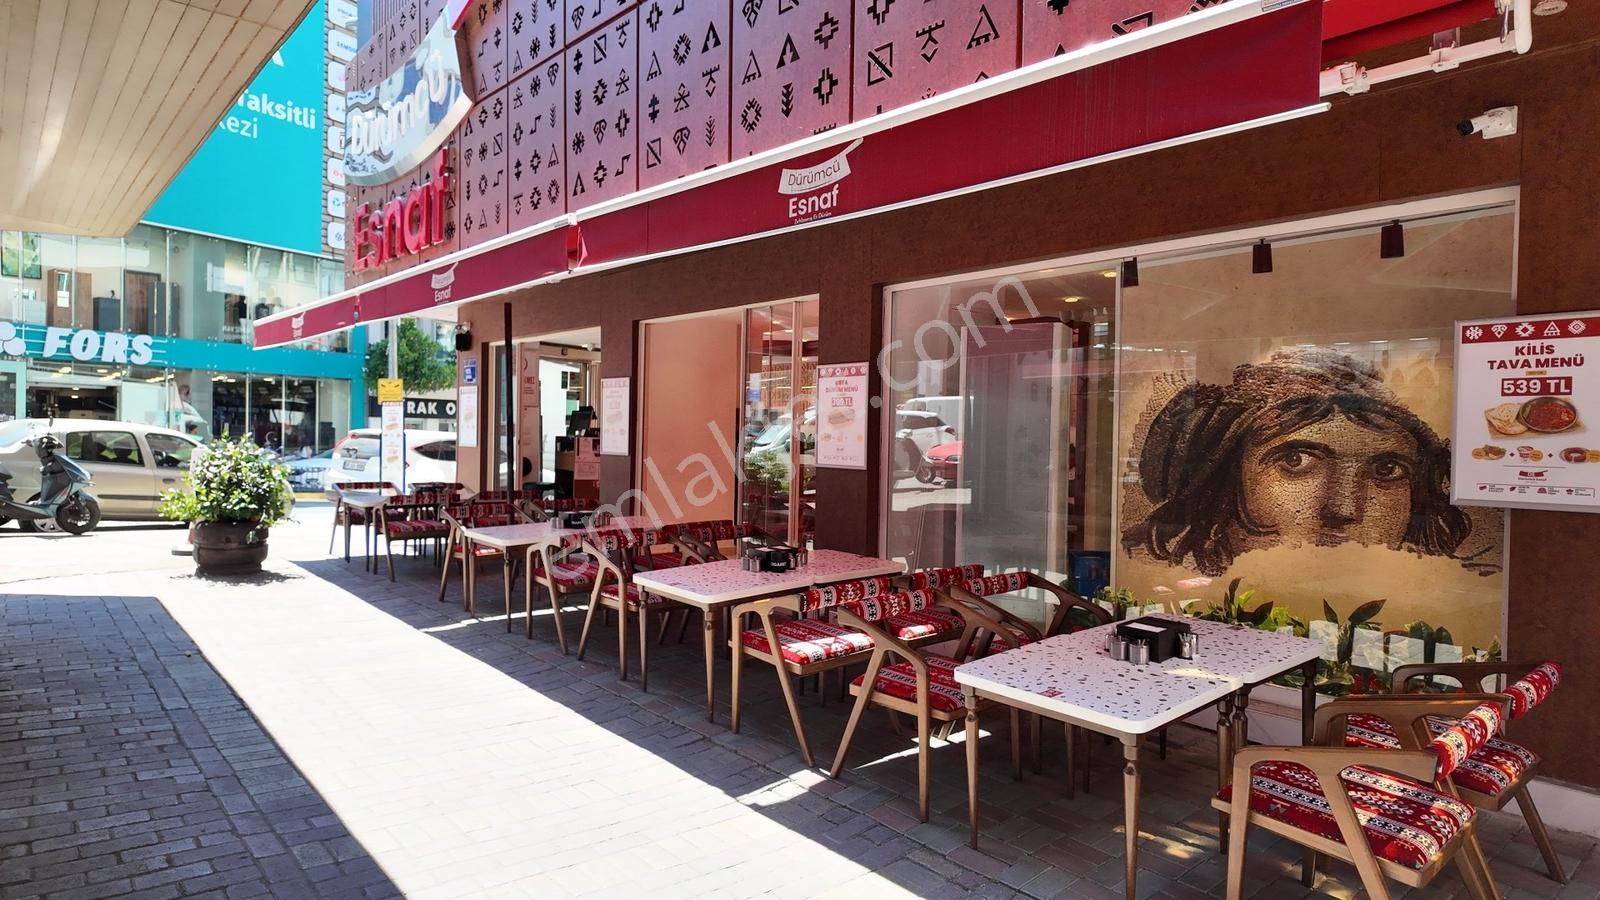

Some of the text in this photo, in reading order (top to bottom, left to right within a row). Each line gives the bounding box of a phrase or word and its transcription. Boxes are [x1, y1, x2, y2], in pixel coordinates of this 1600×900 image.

[219, 115, 258, 139] ezi
[788, 160, 841, 187] Dürümcü
[353, 146, 449, 273] Esnaf
[788, 184, 839, 218] Esnaf
[434, 285, 452, 302] Esnaf
[42, 326, 153, 365] FORS
[1515, 342, 1555, 356] KİLİS
[1487, 353, 1585, 370] TAVA MENÜ
[1503, 379, 1571, 394] 539 TL
